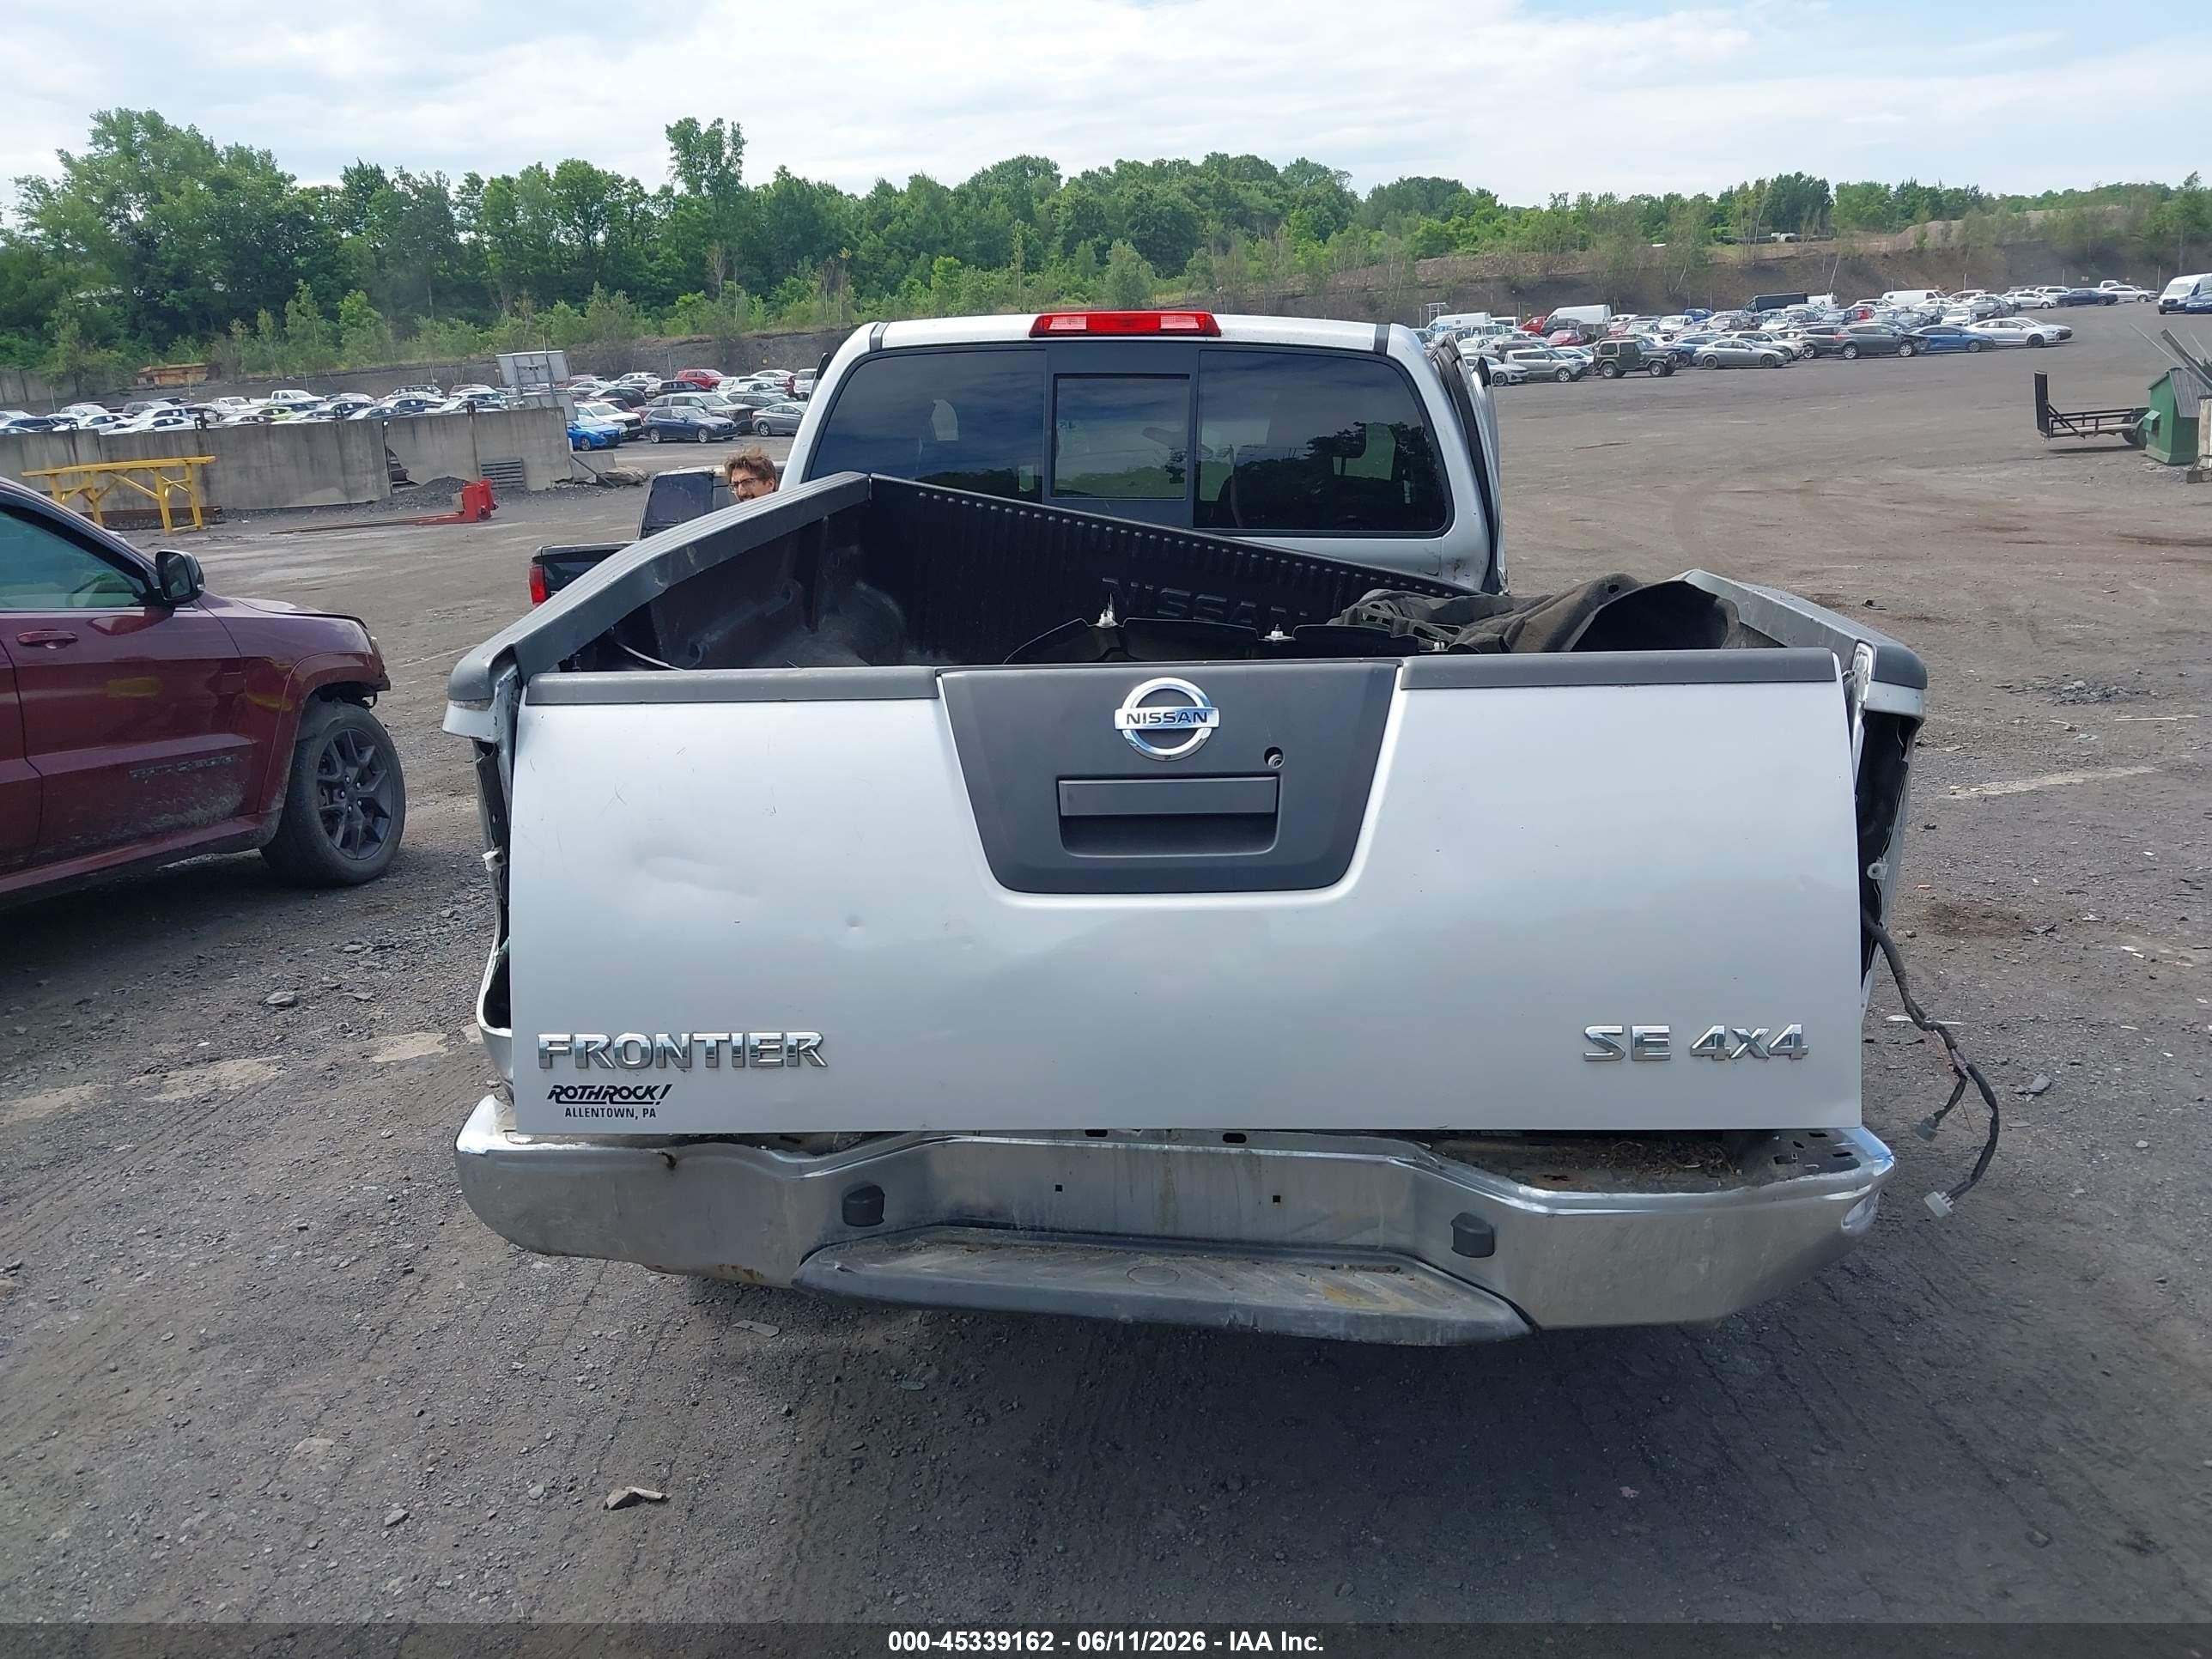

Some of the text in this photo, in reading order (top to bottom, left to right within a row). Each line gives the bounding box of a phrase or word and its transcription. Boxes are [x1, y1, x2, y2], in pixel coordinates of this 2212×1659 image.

[1126, 711, 1207, 725] NISSAN
[537, 1031, 828, 1069] FRONTIER
[1583, 1024, 1671, 1061] SE
[547, 1084, 673, 1106] ROTHROCK!
[564, 1107, 656, 1120] ALLENTOWN, PA
